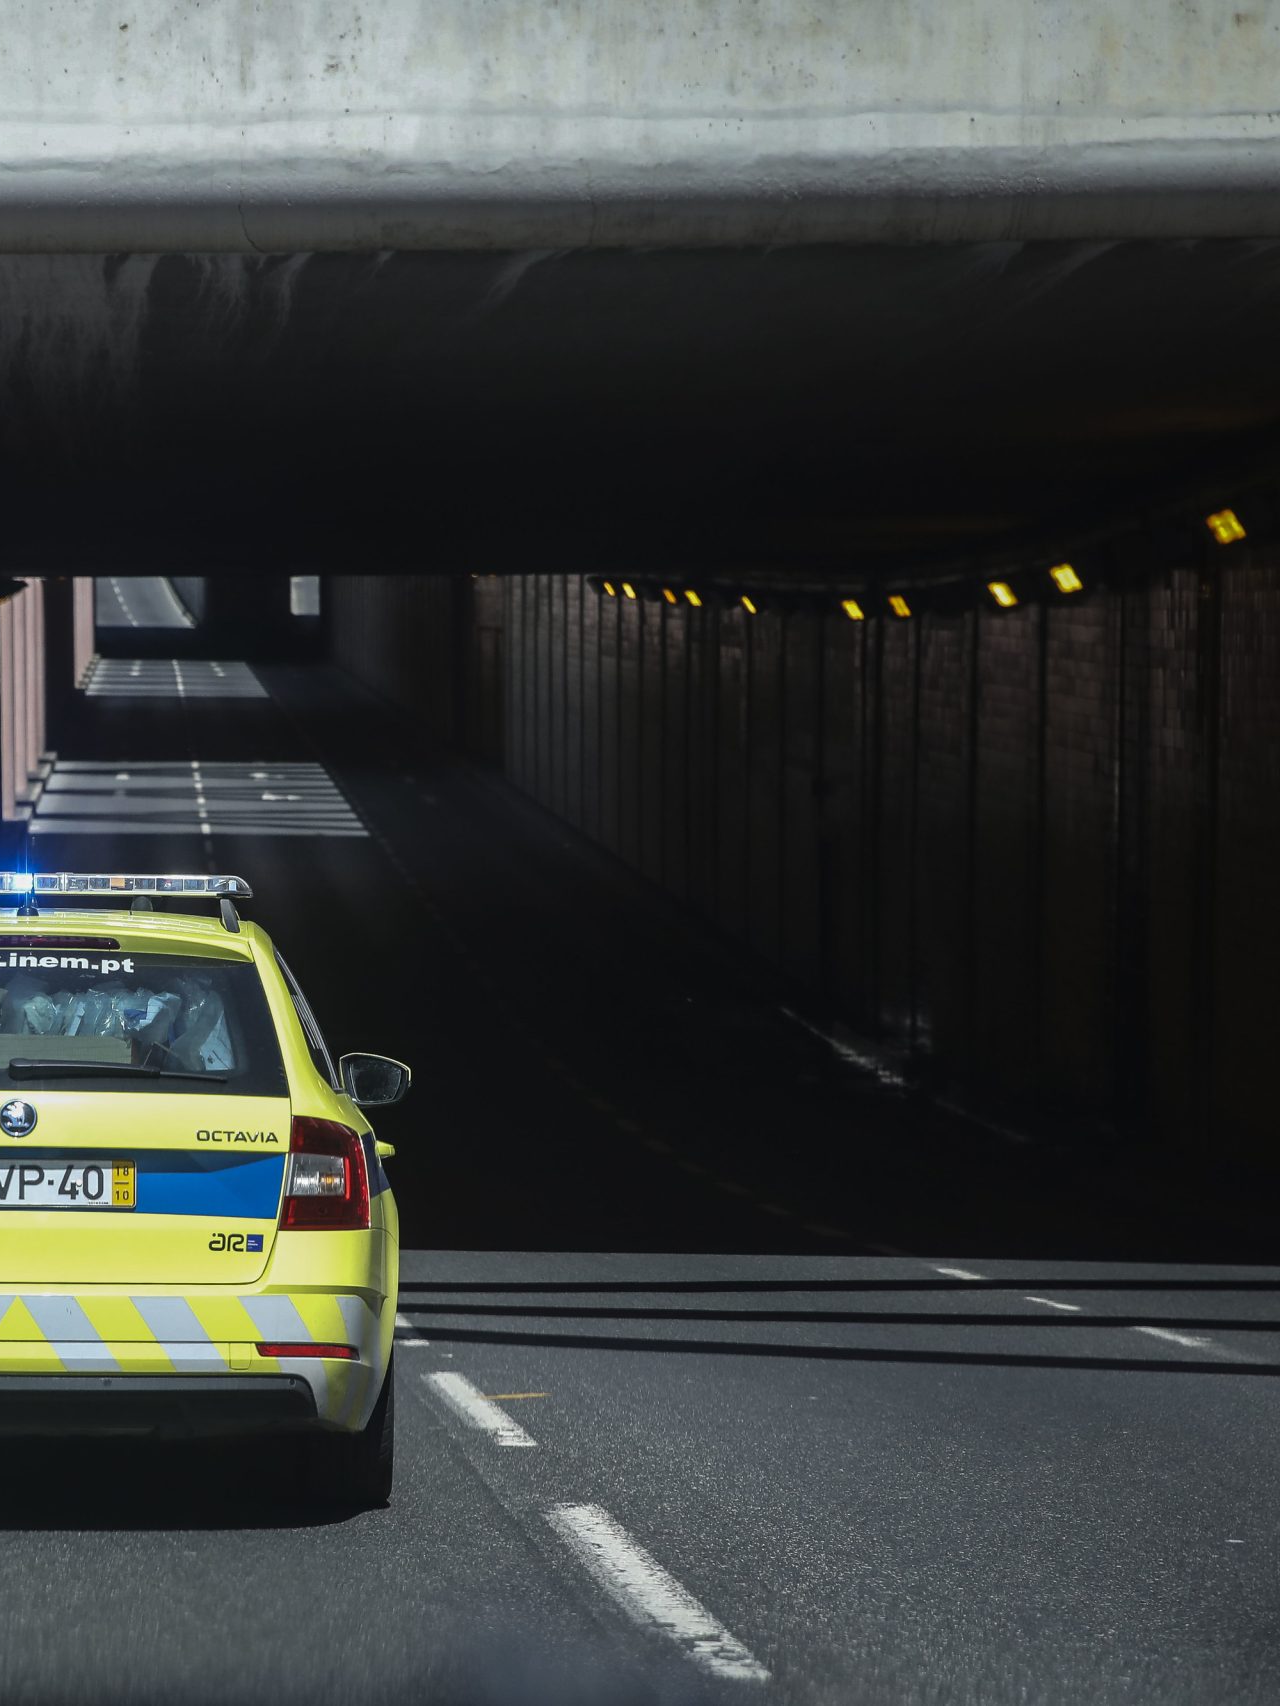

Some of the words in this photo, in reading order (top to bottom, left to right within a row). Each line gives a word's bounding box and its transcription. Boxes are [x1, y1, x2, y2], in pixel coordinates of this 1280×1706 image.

[196, 1130, 279, 1143] OCTAVIA
[116, 1166, 129, 1176] 18
[116, 1190, 129, 1200] 10
